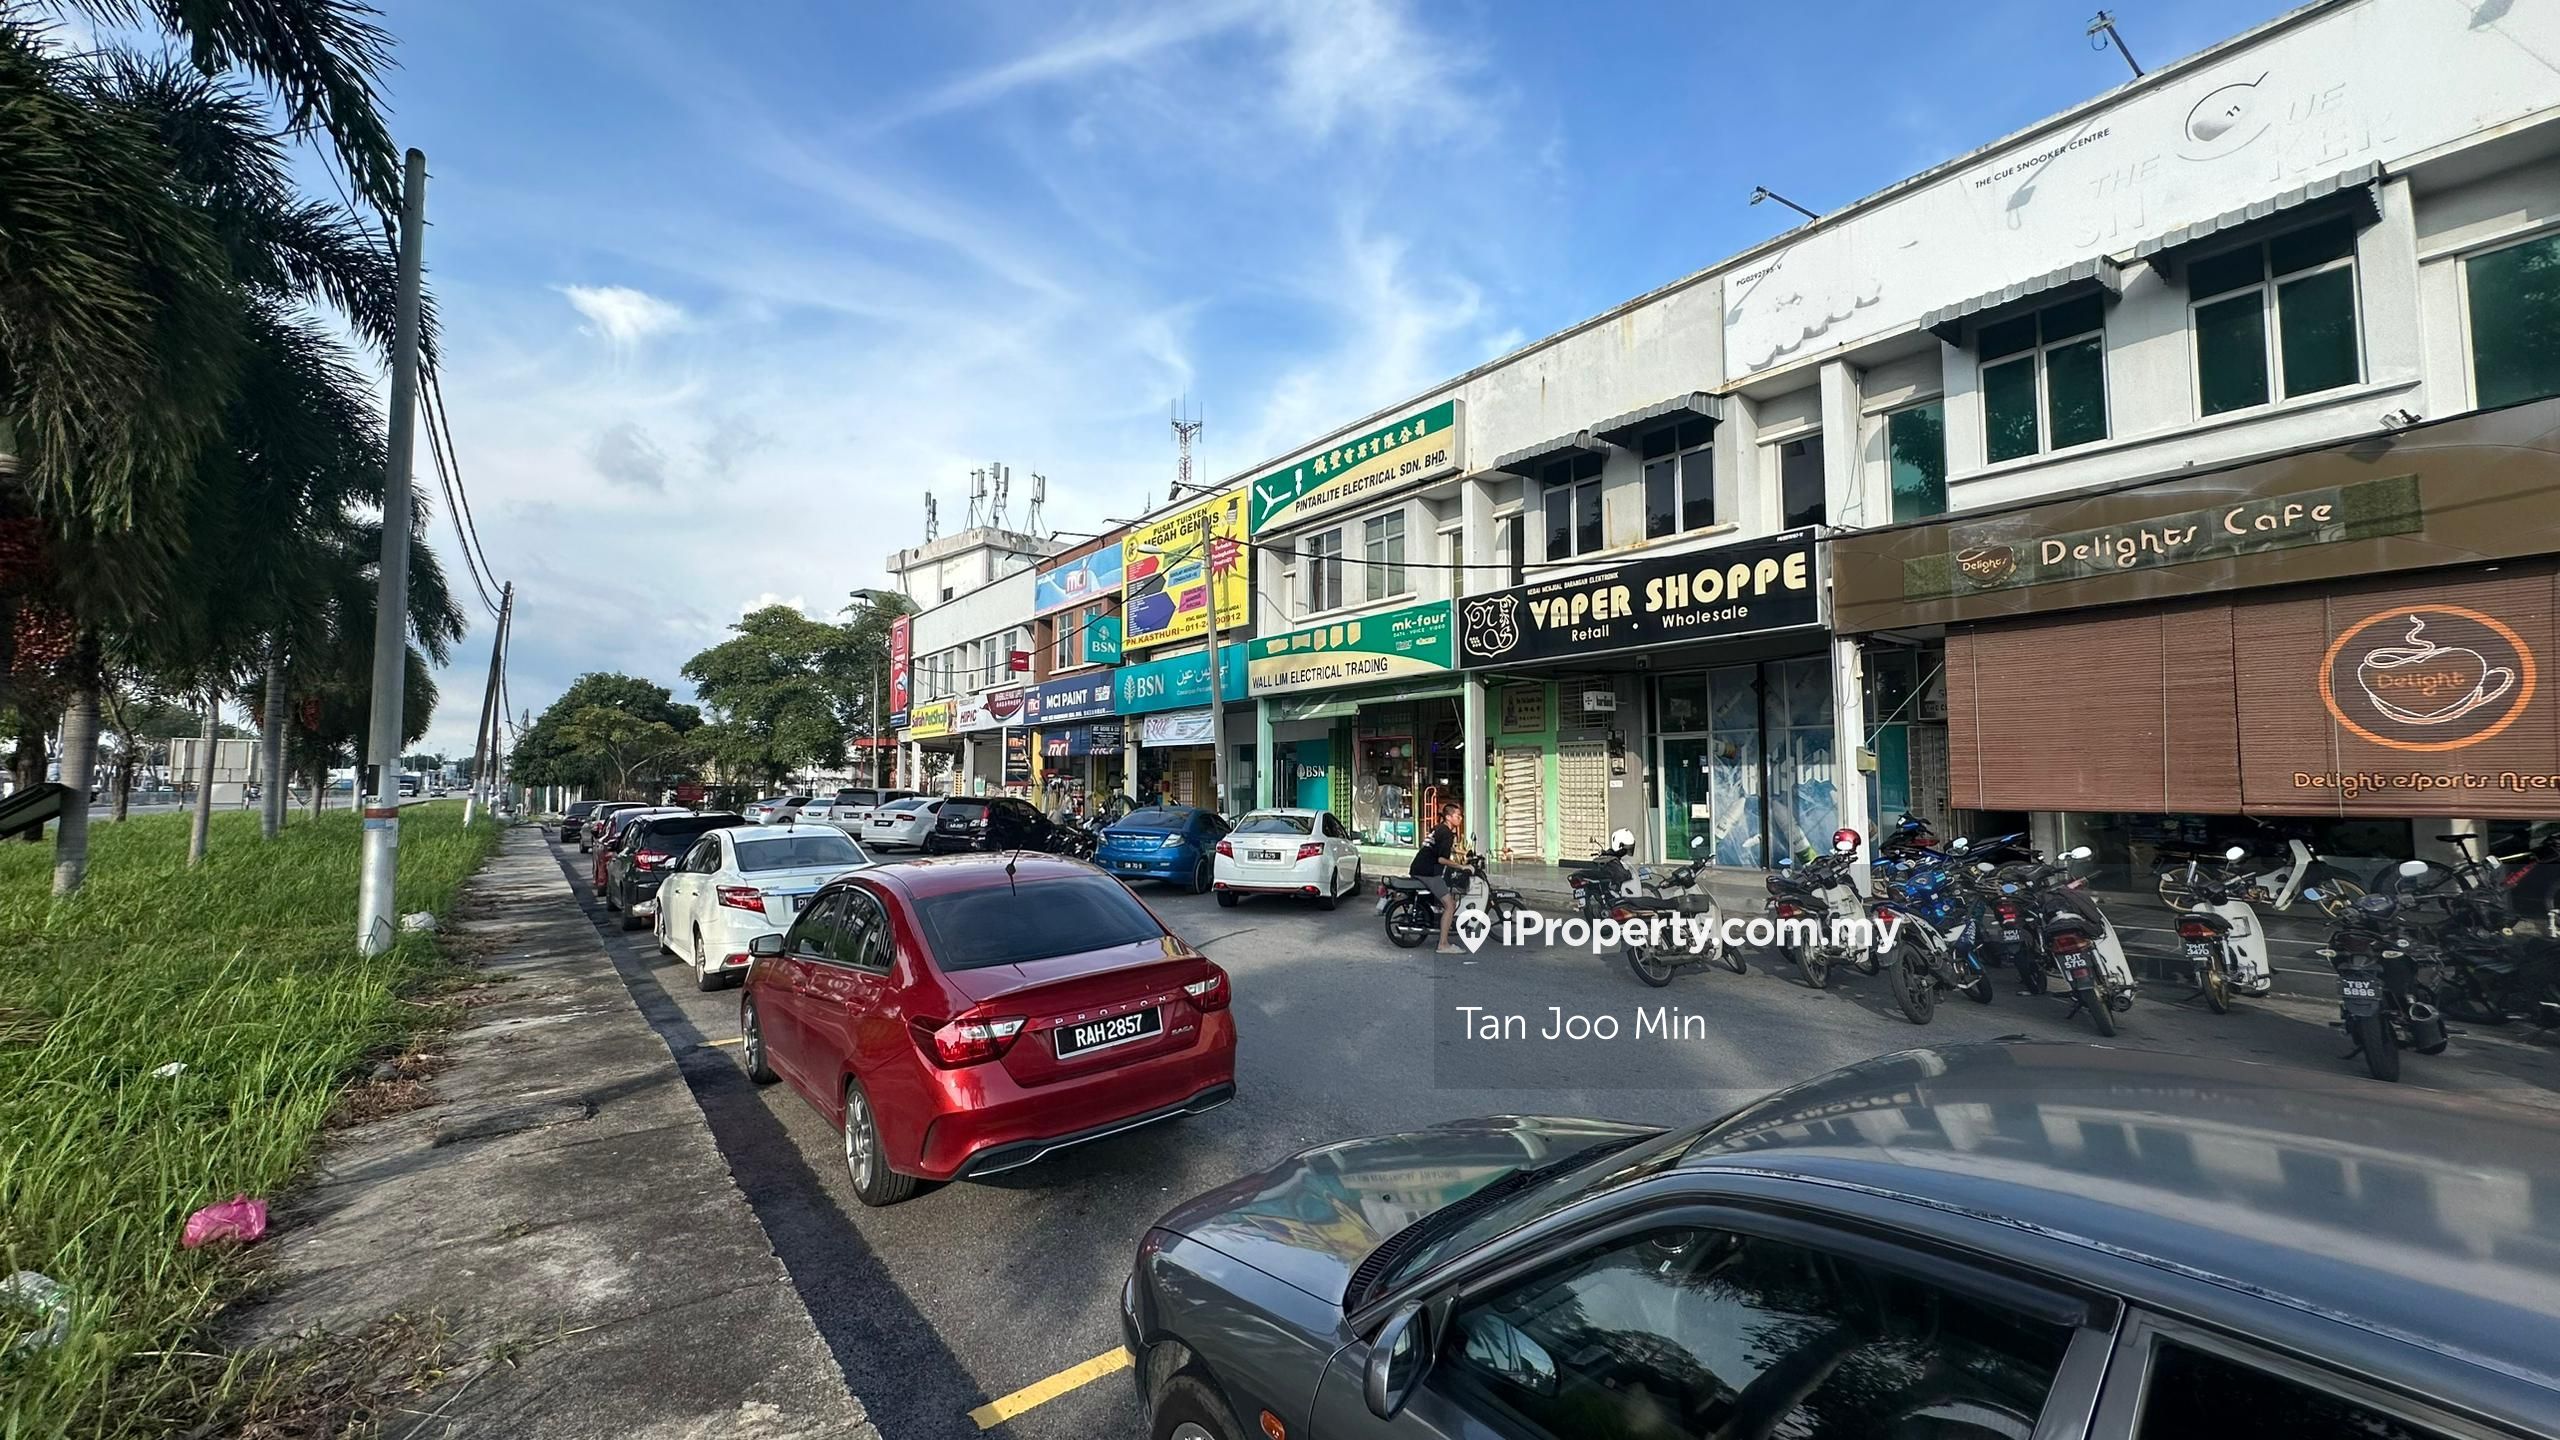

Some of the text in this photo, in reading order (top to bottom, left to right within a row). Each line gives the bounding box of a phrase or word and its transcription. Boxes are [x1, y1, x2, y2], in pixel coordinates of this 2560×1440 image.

[1975, 127, 2111, 189] THE CUE SNOOKER CENTRE
[1295, 449, 1448, 513] PINTARLITE ELECTRICAL SDN. BHD.
[1153, 508, 1208, 536] PUSAT TUISYEN
[2040, 503, 2333, 569] Delights Cafe
[1962, 556, 2008, 575] Delights
[1528, 551, 1807, 631] VAPER SHOPPE
[1391, 613, 1447, 632] mk-four
[1662, 605, 1749, 629] Wholesale
[1092, 641, 1116, 653] BSN
[1252, 656, 1388, 689] WALL LIM ELECTRICAL TRADING
[2376, 671, 2465, 697] Delight
[1137, 673, 1165, 698] BSN
[1046, 693, 1061, 709] MCI
[1061, 689, 1088, 707] PAINT
[1306, 765, 1325, 778] BSN
[2293, 771, 2387, 799] Delight
[2064, 959, 2086, 969] 5713
[2065, 953, 2081, 962] PJT
[2347, 981, 2370, 989] TBY
[1055, 995, 1167, 1025] PROTON
[1074, 1013, 1143, 1048] RAH 2857
